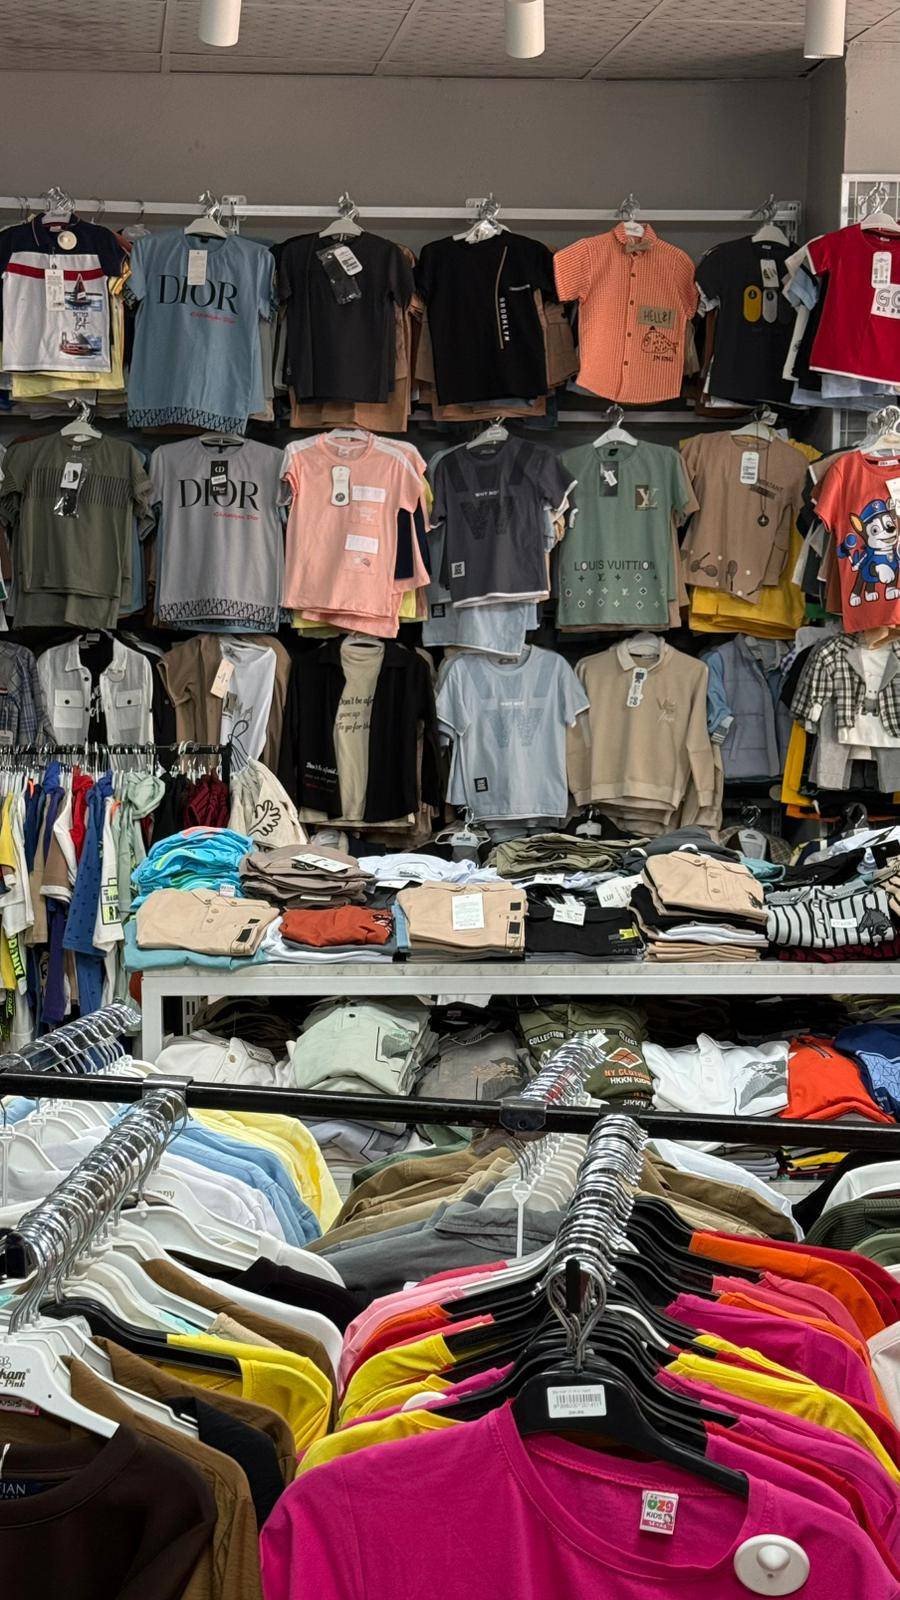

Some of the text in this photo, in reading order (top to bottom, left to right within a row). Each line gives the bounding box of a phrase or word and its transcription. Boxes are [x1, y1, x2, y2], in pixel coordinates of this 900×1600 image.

[157, 274, 239, 315] DIOR
[500, 297, 510, 341] BROOKLYN
[178, 478, 260, 511] DIOR
[574, 560, 604, 571] LOUIS
[529, 1031, 564, 1045] COLLECTION
[646, 1511, 663, 1520] KIDS
